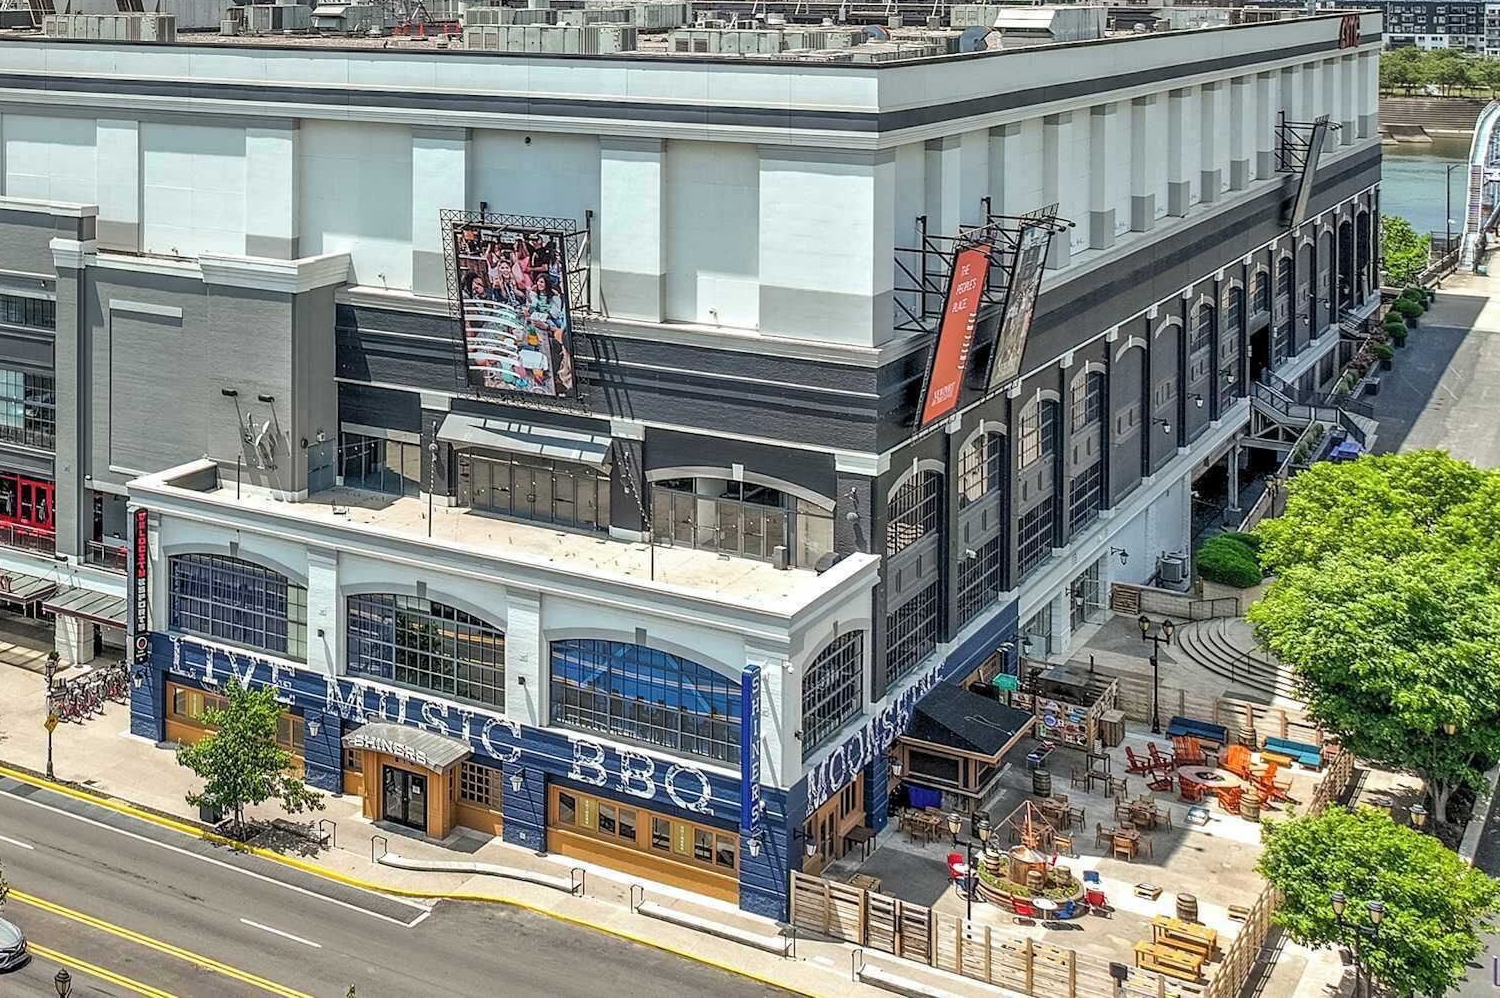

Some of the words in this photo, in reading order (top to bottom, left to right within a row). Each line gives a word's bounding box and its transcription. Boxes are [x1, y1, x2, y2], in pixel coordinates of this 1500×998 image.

[138, 512, 146, 578] VELOCITY
[168, 634, 296, 705] LIVE
[322, 673, 523, 763] MUSIC
[567, 735, 715, 816] BBQ
[353, 736, 429, 765] SHINERS
[750, 673, 761, 823] SHINERS
